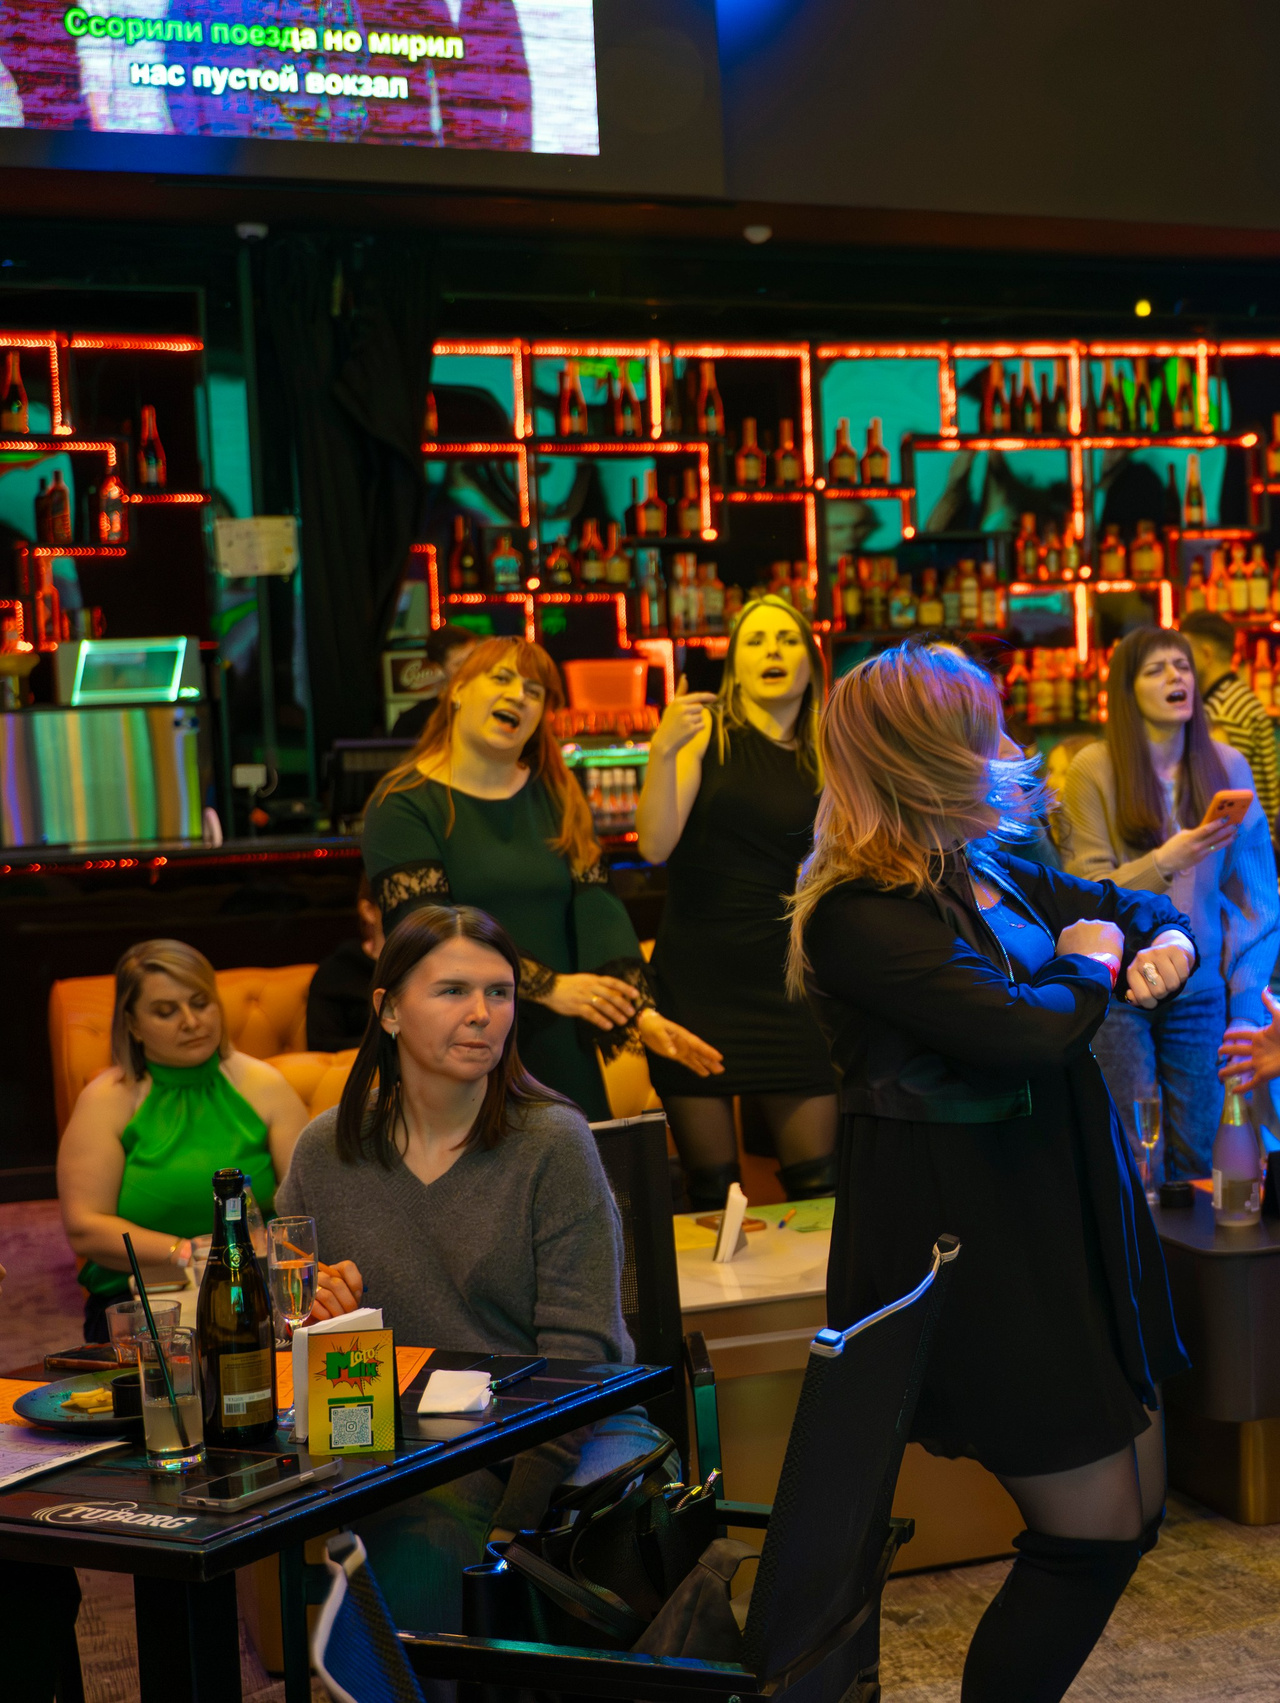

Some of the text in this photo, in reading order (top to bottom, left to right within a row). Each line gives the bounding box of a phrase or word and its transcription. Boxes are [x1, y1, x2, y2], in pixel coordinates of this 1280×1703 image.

[64, 7, 464, 62] Ссорили поезда но мирил
[130, 62, 409, 98] нас пустой вокзал
[326, 1350, 378, 1380] MIX
[350, 1348, 375, 1368] LOTO
[59, 1506, 198, 1529] TUBORG
